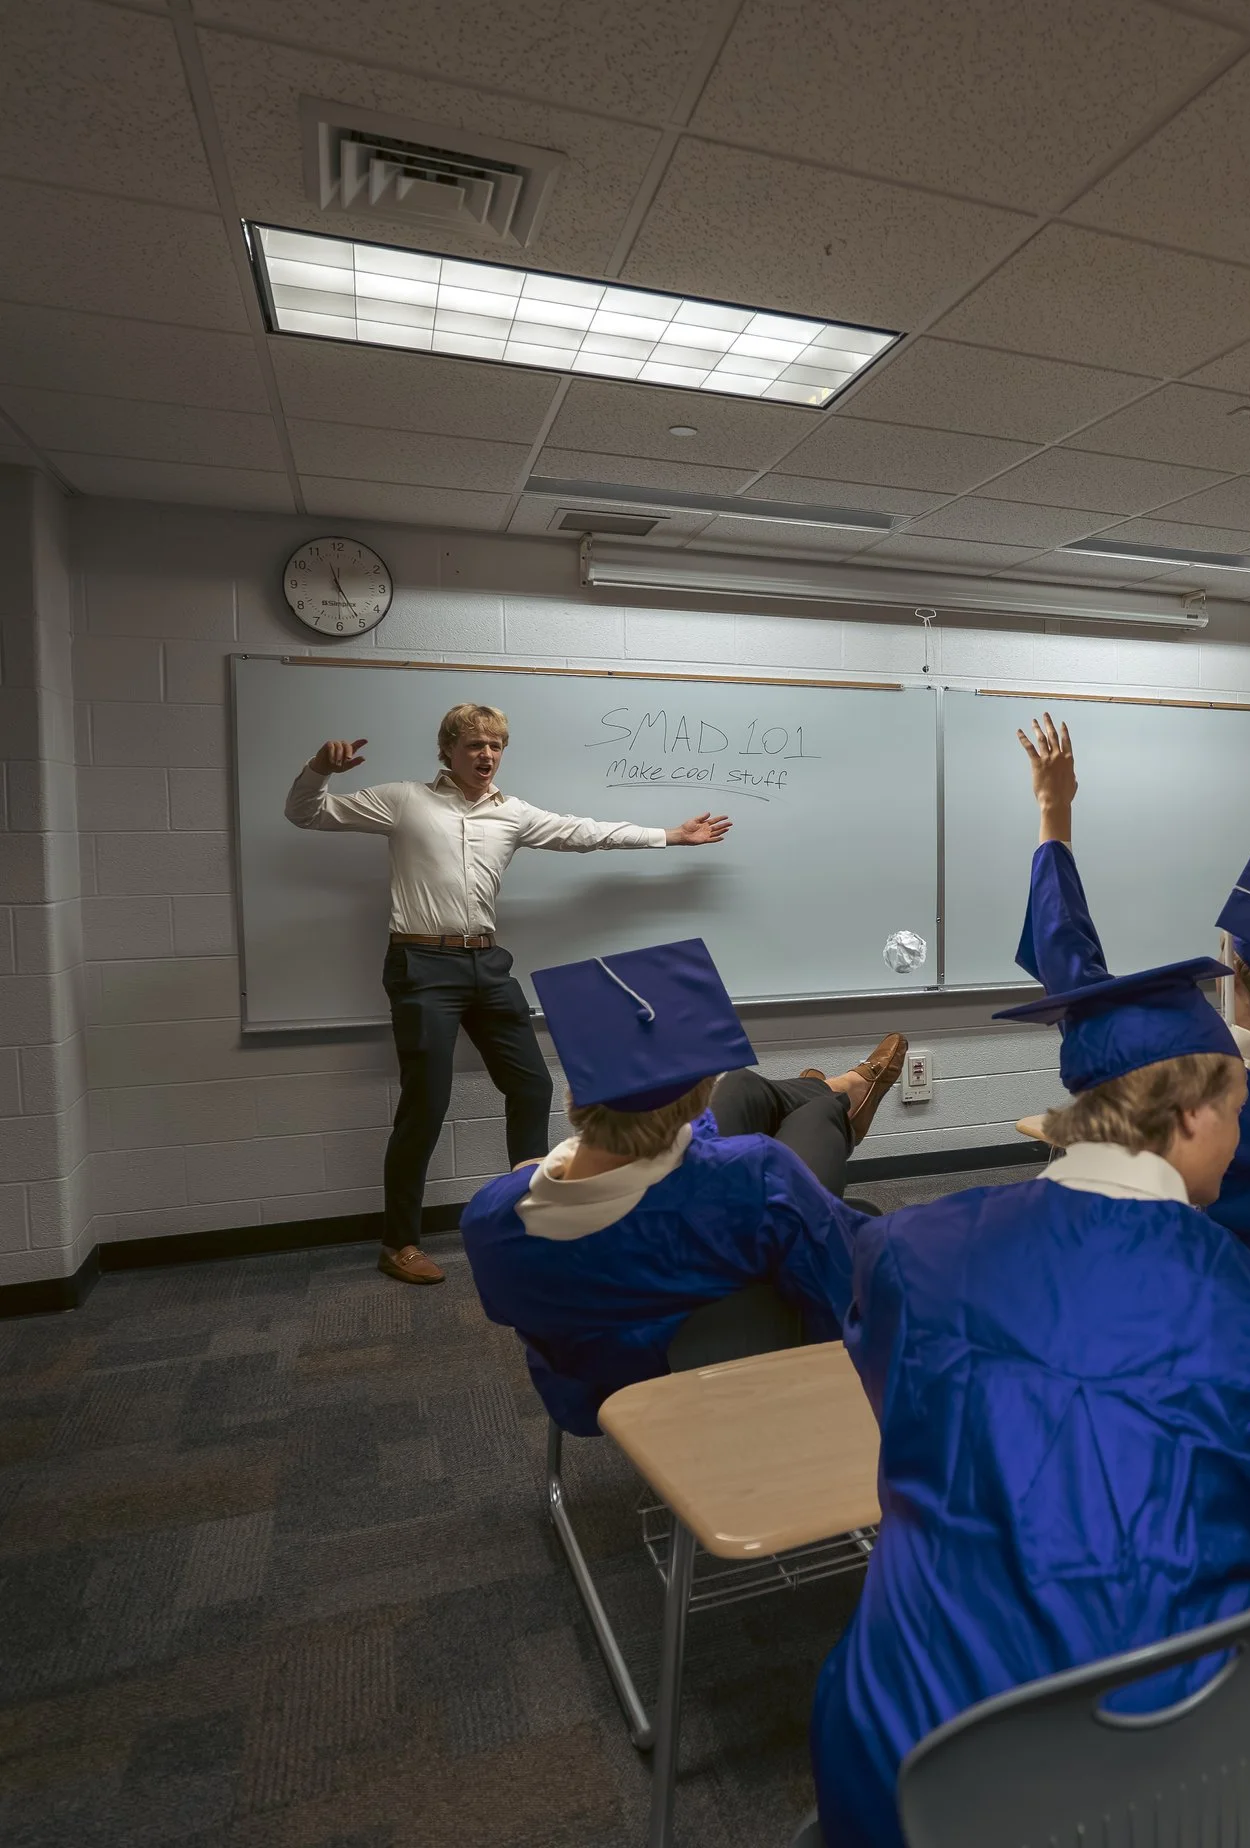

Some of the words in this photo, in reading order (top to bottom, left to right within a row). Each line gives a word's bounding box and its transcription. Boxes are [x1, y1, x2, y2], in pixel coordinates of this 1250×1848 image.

[331, 542, 344, 551] 12
[309, 547, 319, 556] 11
[294, 560, 306, 570] 10
[373, 565, 380, 574] 2
[290, 580, 298, 589] 9
[378, 585, 386, 594] 3
[297, 601, 304, 610] 8
[373, 605, 380, 613] 4
[313, 617, 320, 625] 7
[358, 619, 366, 628] 5
[336, 622, 344, 631] 6
[584, 708, 729, 754] SMAD
[739, 718, 822, 759] 101
[606, 758, 665, 780] Make
[670, 763, 715, 782] cool
[726, 769, 788, 789] stuff
